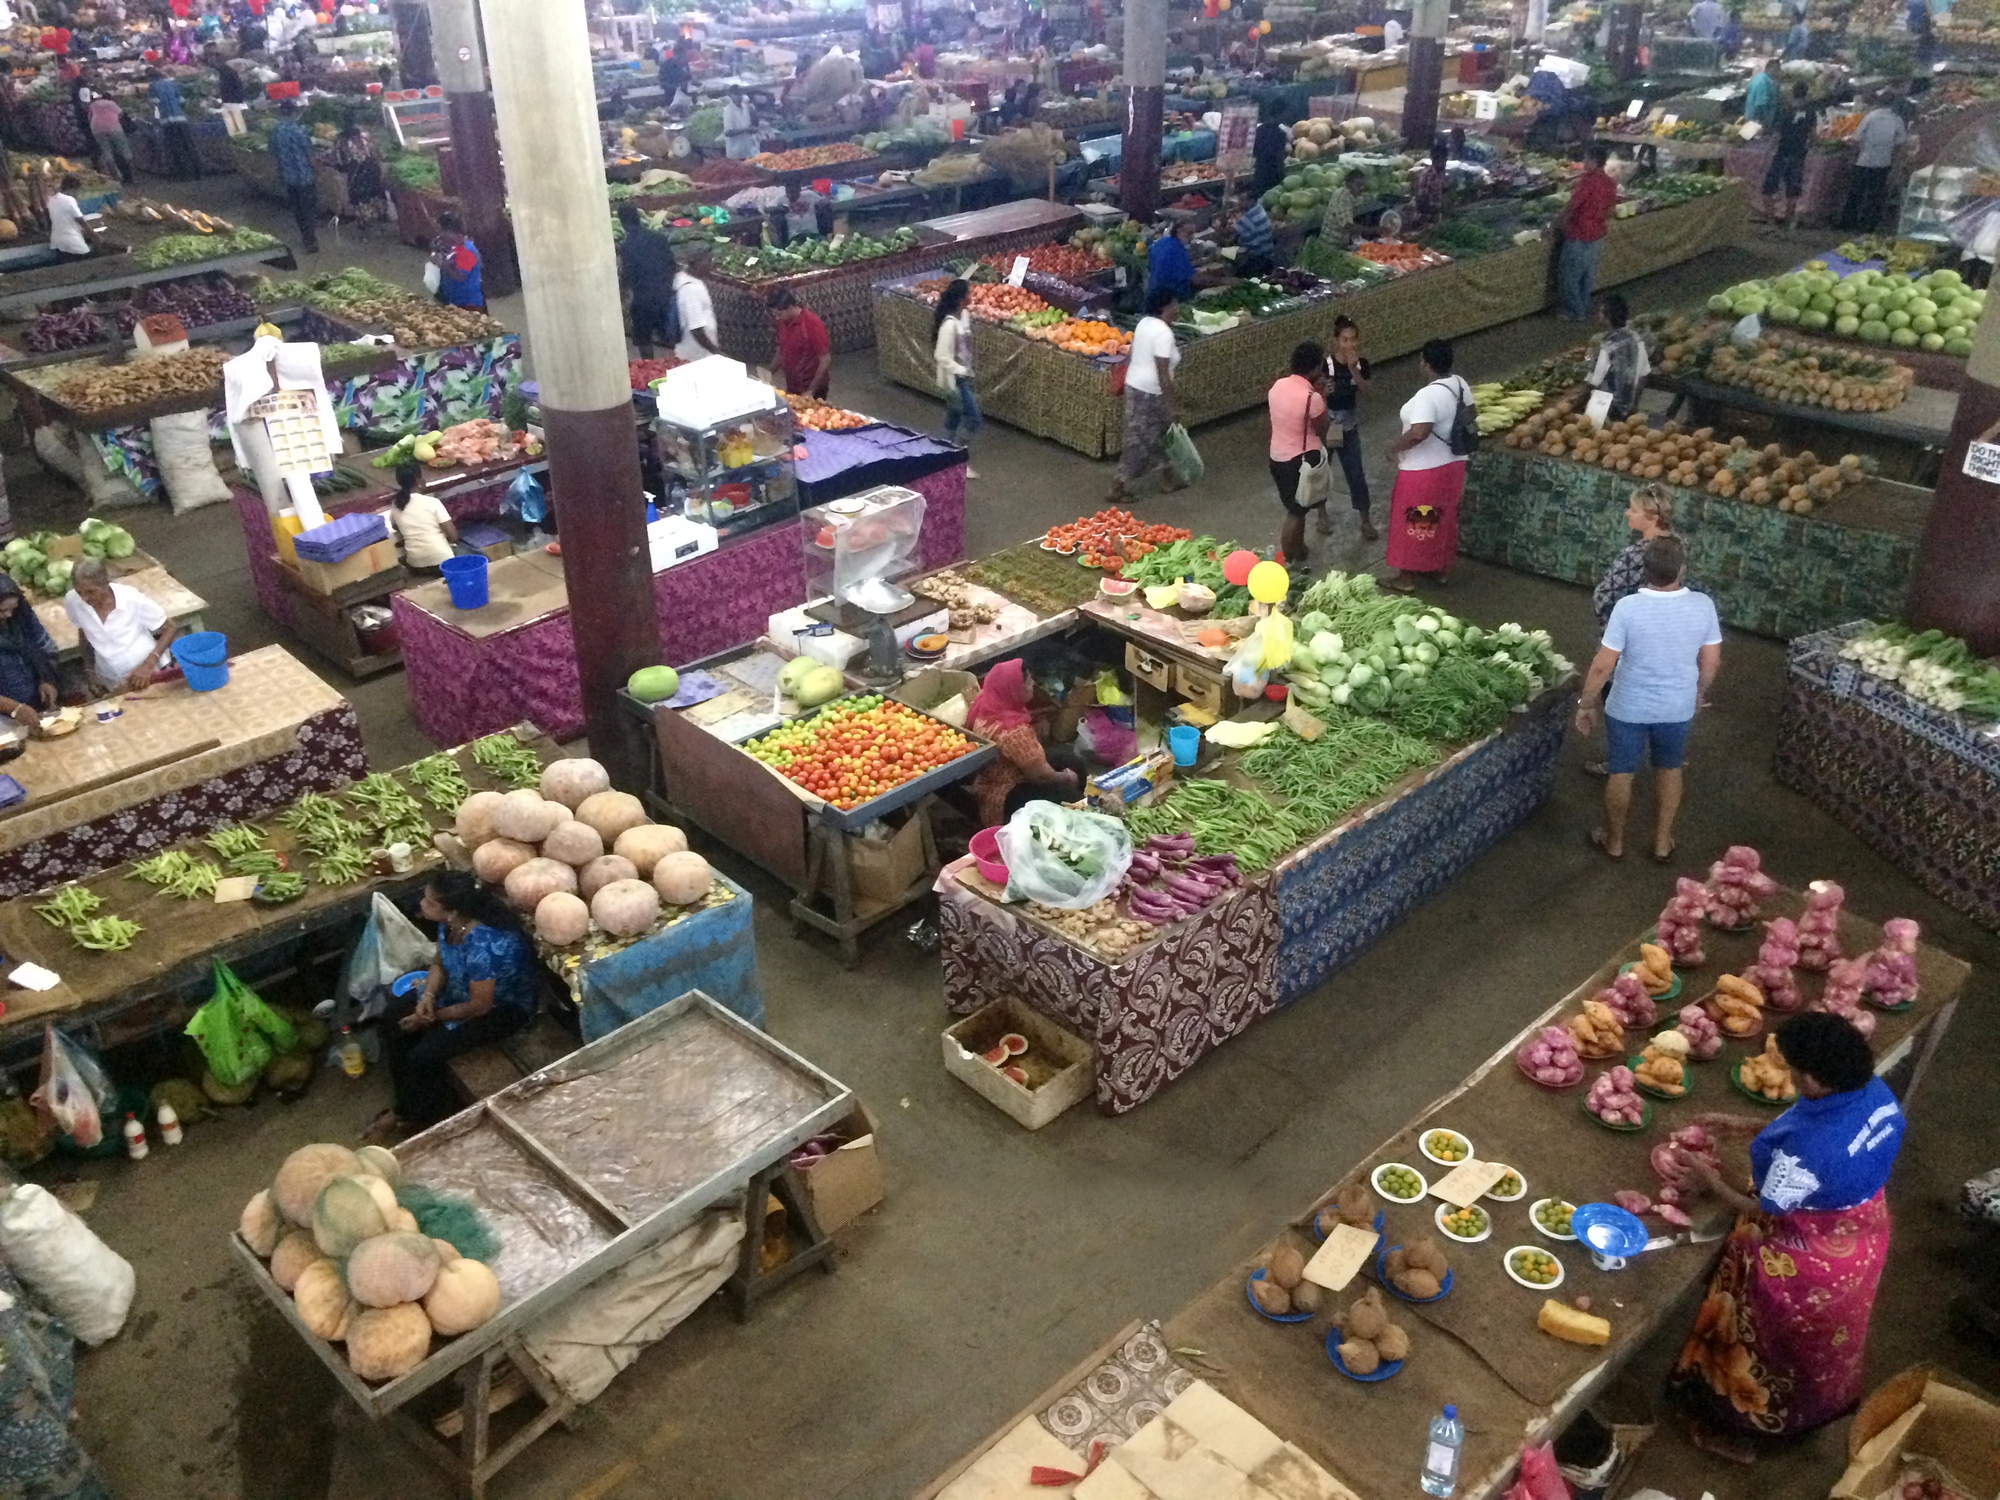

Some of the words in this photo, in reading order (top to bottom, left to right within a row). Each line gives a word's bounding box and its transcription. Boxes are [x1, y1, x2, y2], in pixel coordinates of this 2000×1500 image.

[1971, 444, 1986, 456] DO
[1970, 453, 2000, 469] RIGHT
[1968, 462, 1997, 477] THING
